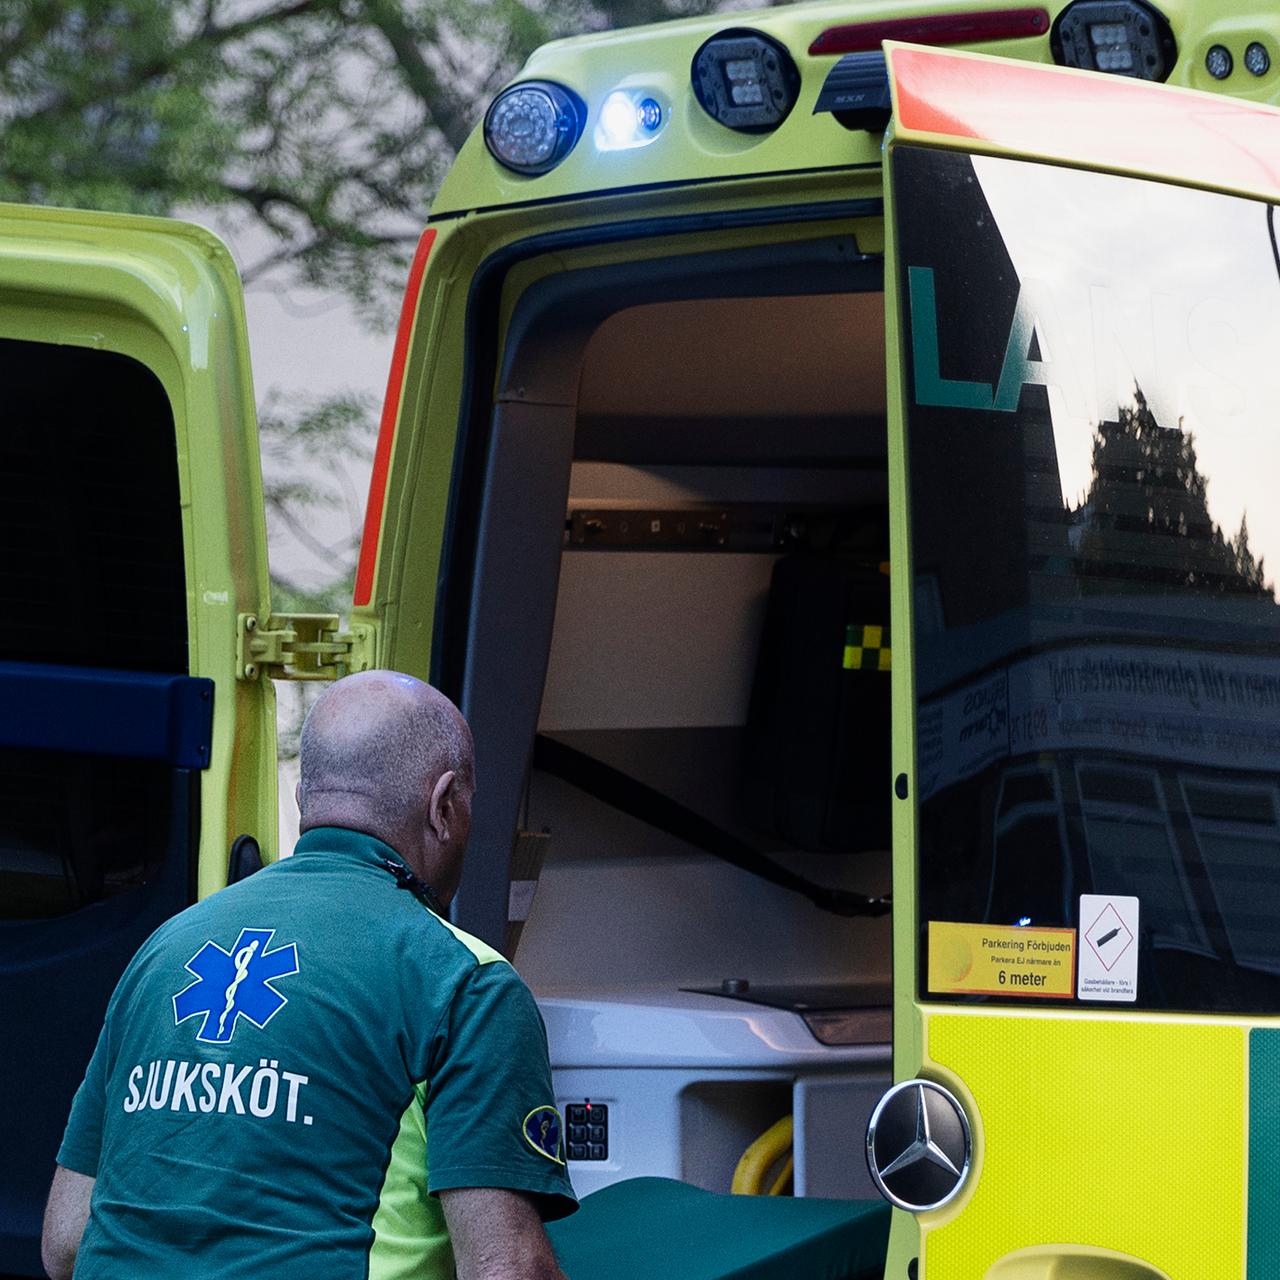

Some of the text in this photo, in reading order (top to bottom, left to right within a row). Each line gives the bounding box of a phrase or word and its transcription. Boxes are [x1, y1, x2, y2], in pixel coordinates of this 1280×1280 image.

[982, 938, 1071, 952] Parkering Förbjuden
[991, 956, 1015, 964] Parkera
[1026, 958, 1052, 966] närmare
[998, 970, 1047, 986] 6 meter
[124, 1058, 314, 1126] SJUKSKÖT.
